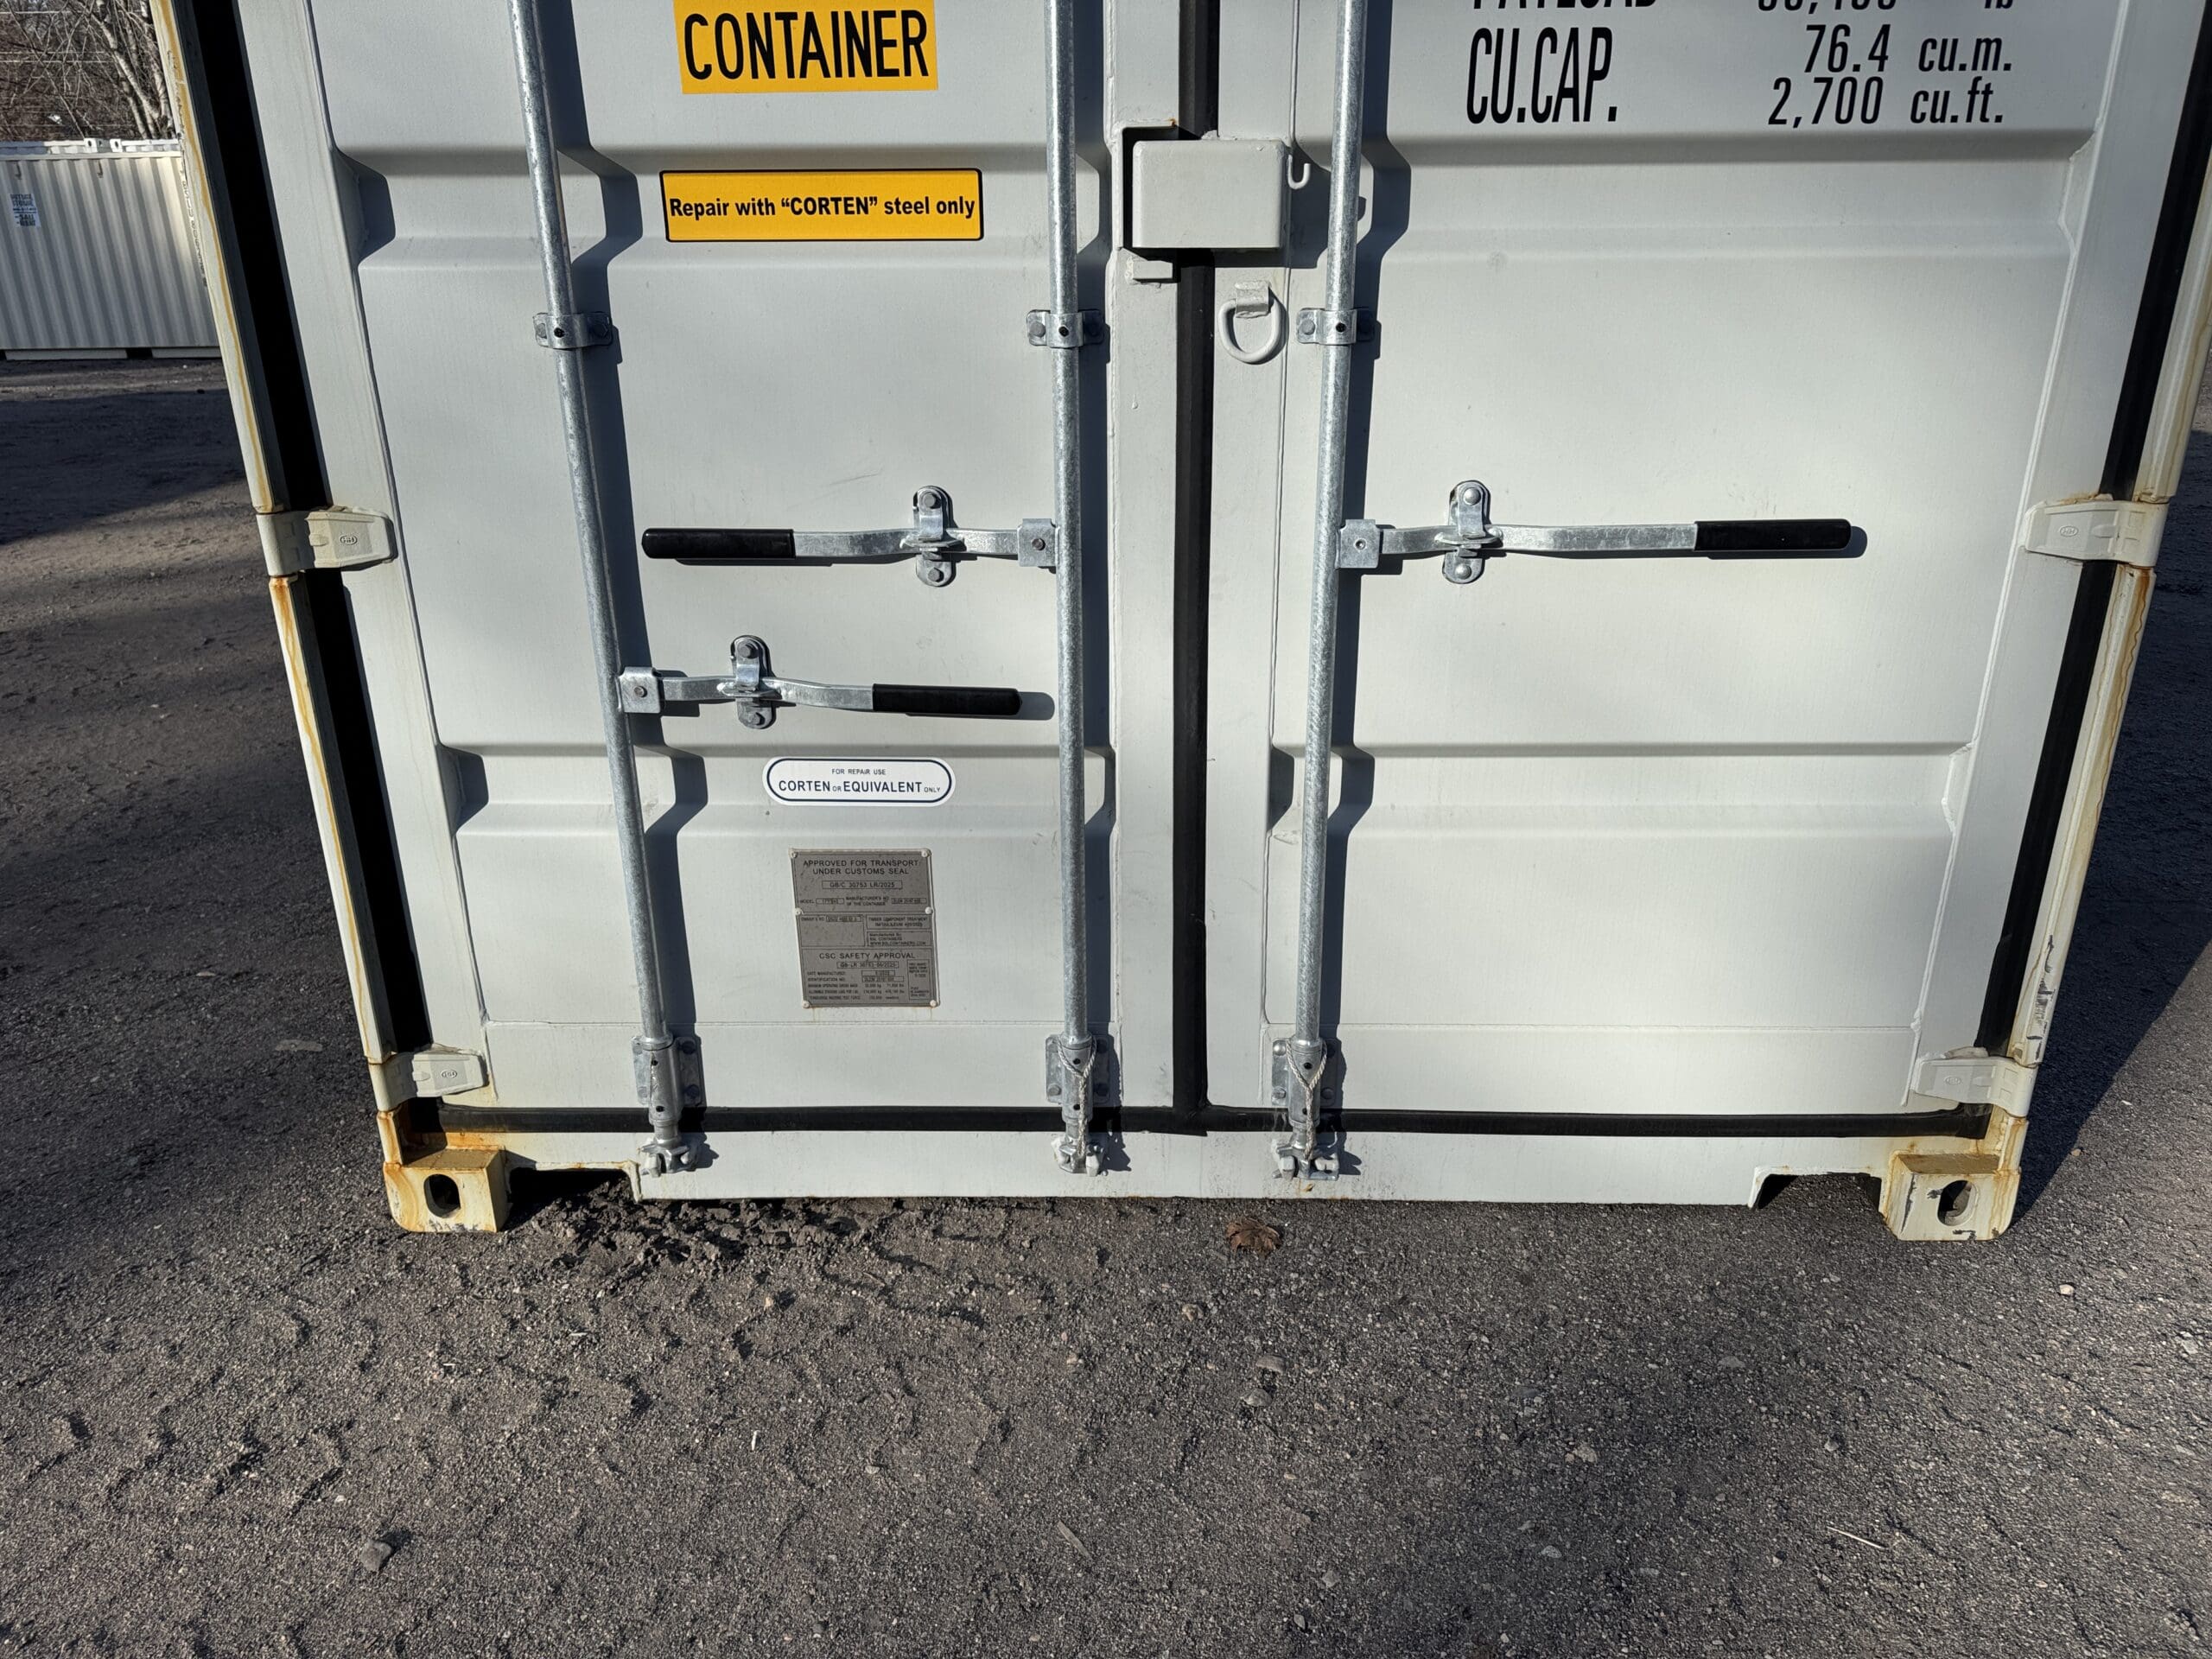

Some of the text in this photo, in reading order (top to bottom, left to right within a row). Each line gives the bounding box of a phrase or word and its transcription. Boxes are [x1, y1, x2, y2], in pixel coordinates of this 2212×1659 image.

[683, 10, 930, 80] CONTAINER
[1804, 23, 2013, 73] 76.4 cu.m.
[1466, 27, 1620, 124] CU.CAP.
[1768, 76, 2005, 129] 2,700 cu.ft.
[670, 196, 976, 221] Repair with “CORTEN” steel only
[779, 779, 831, 792] CORTEN
[843, 780, 923, 794] EQUIVALENT
